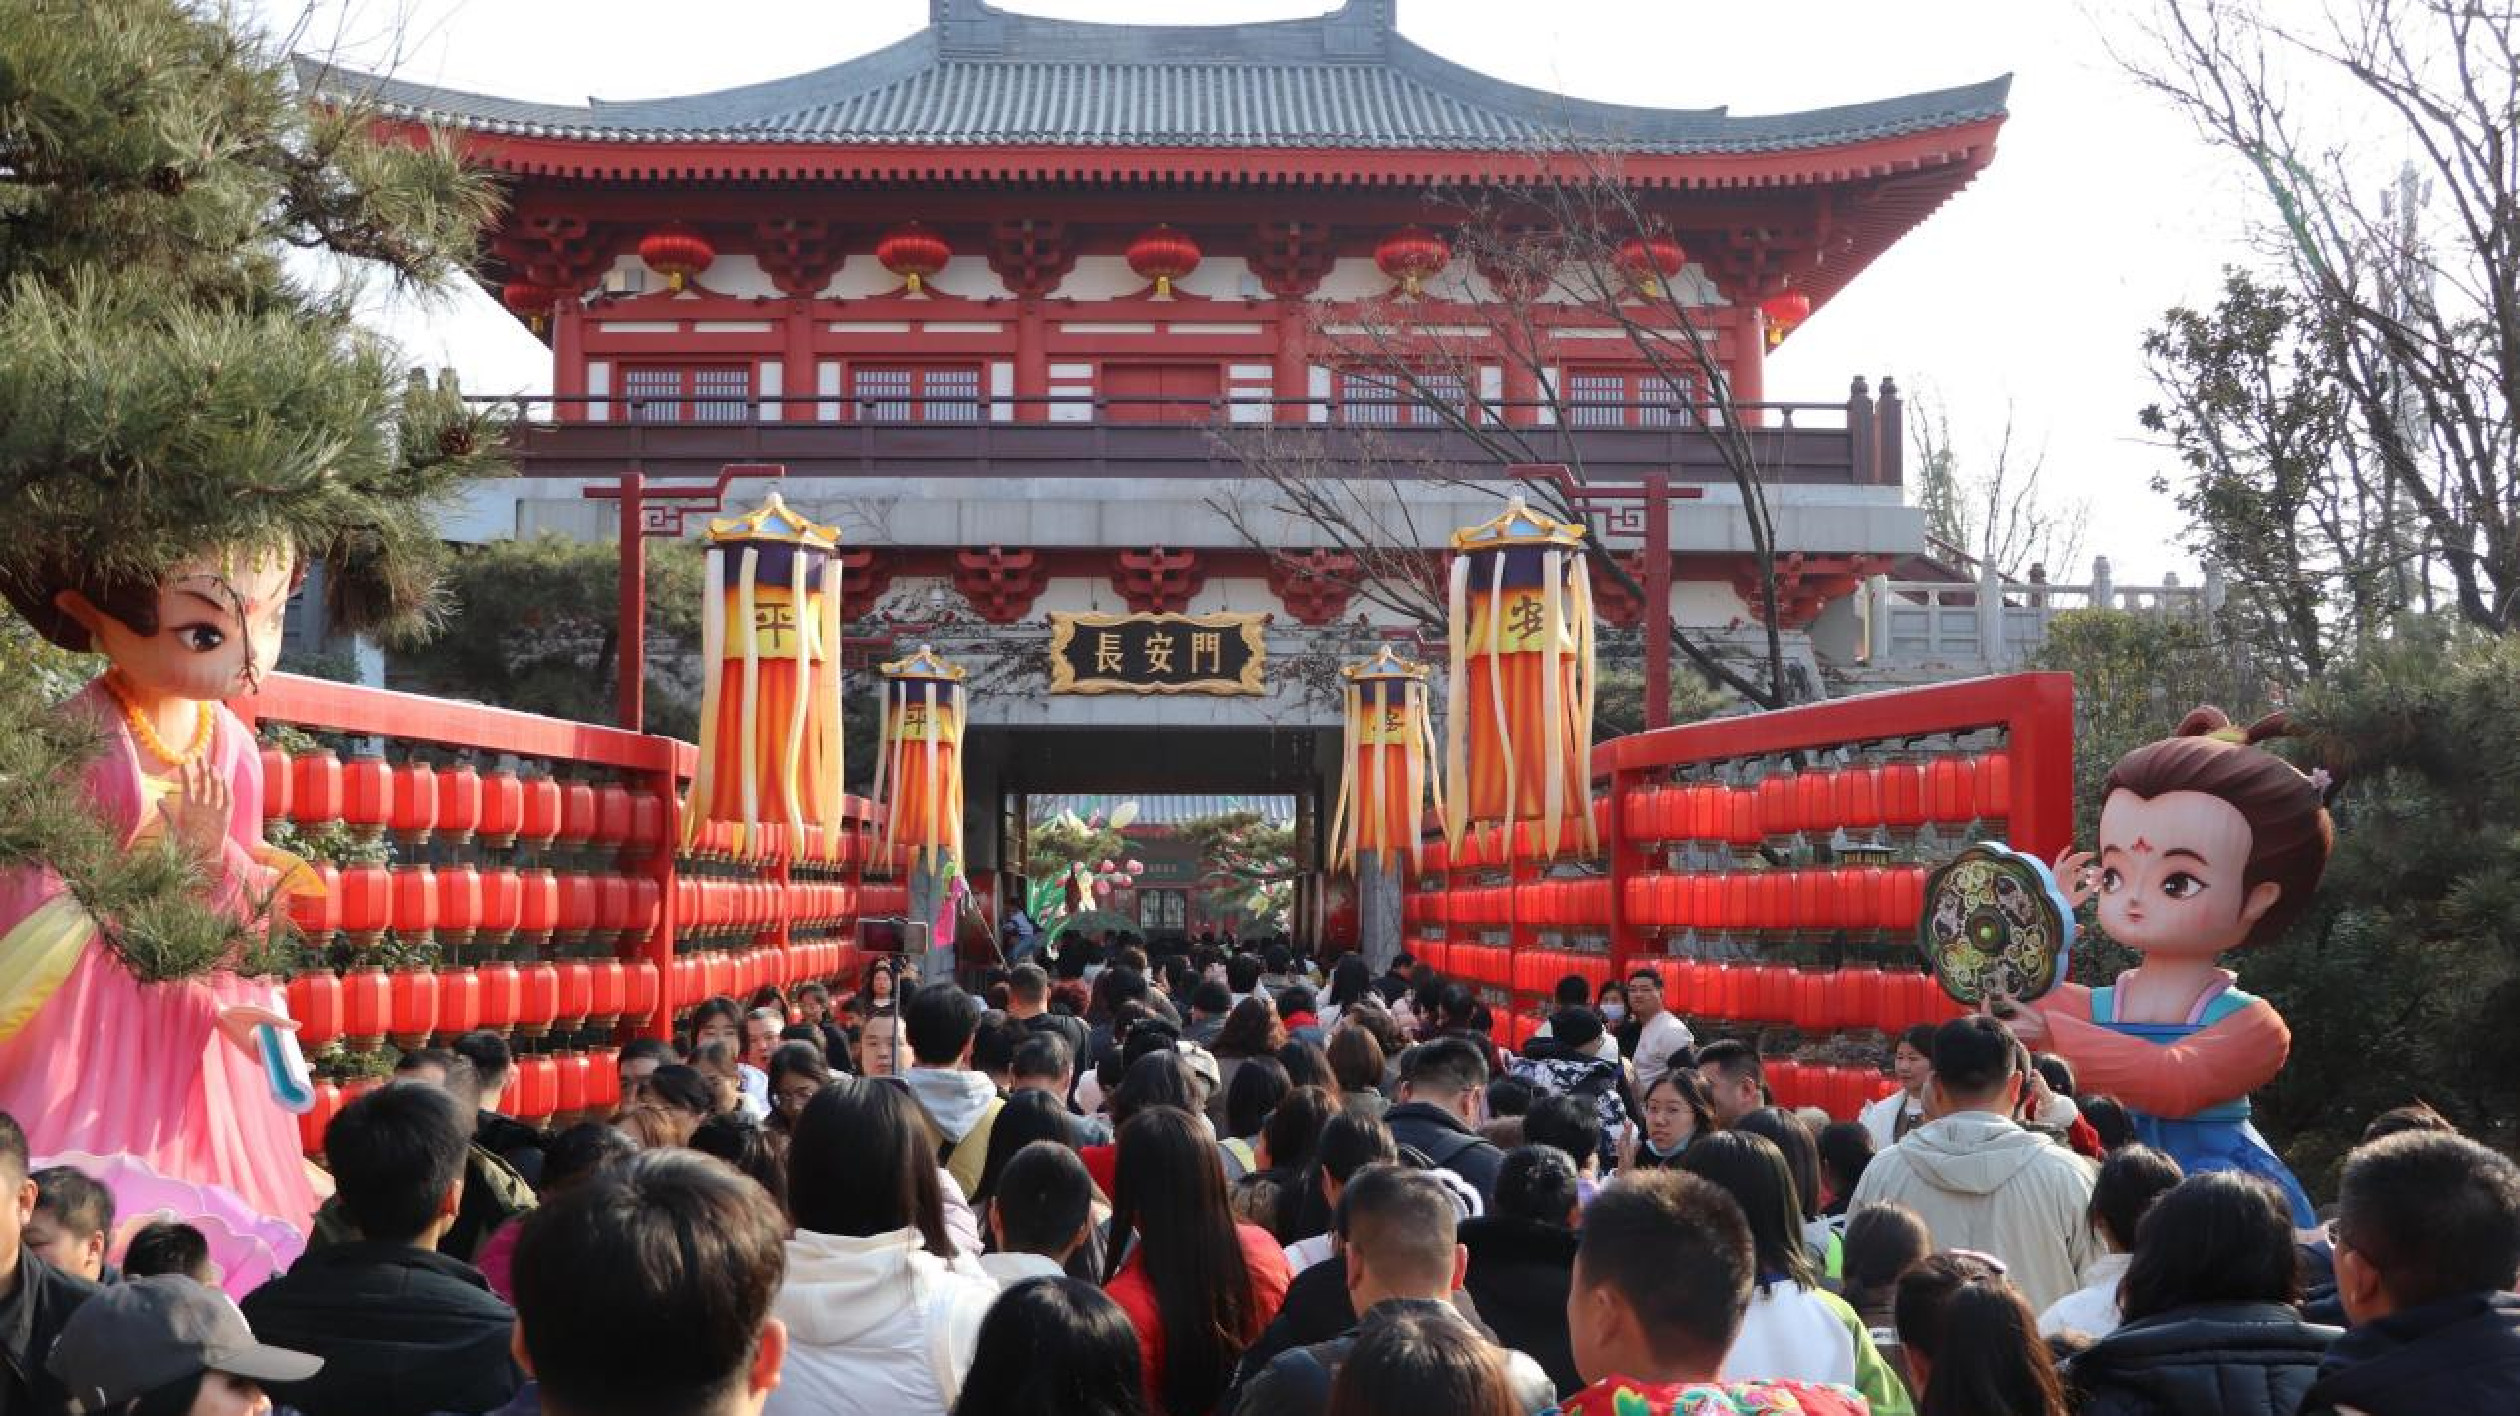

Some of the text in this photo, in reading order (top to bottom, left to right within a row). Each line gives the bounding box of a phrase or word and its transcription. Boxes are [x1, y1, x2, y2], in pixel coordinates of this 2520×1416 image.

[754, 602, 797, 649] 平
[1095, 631, 1221, 674] 長安門
